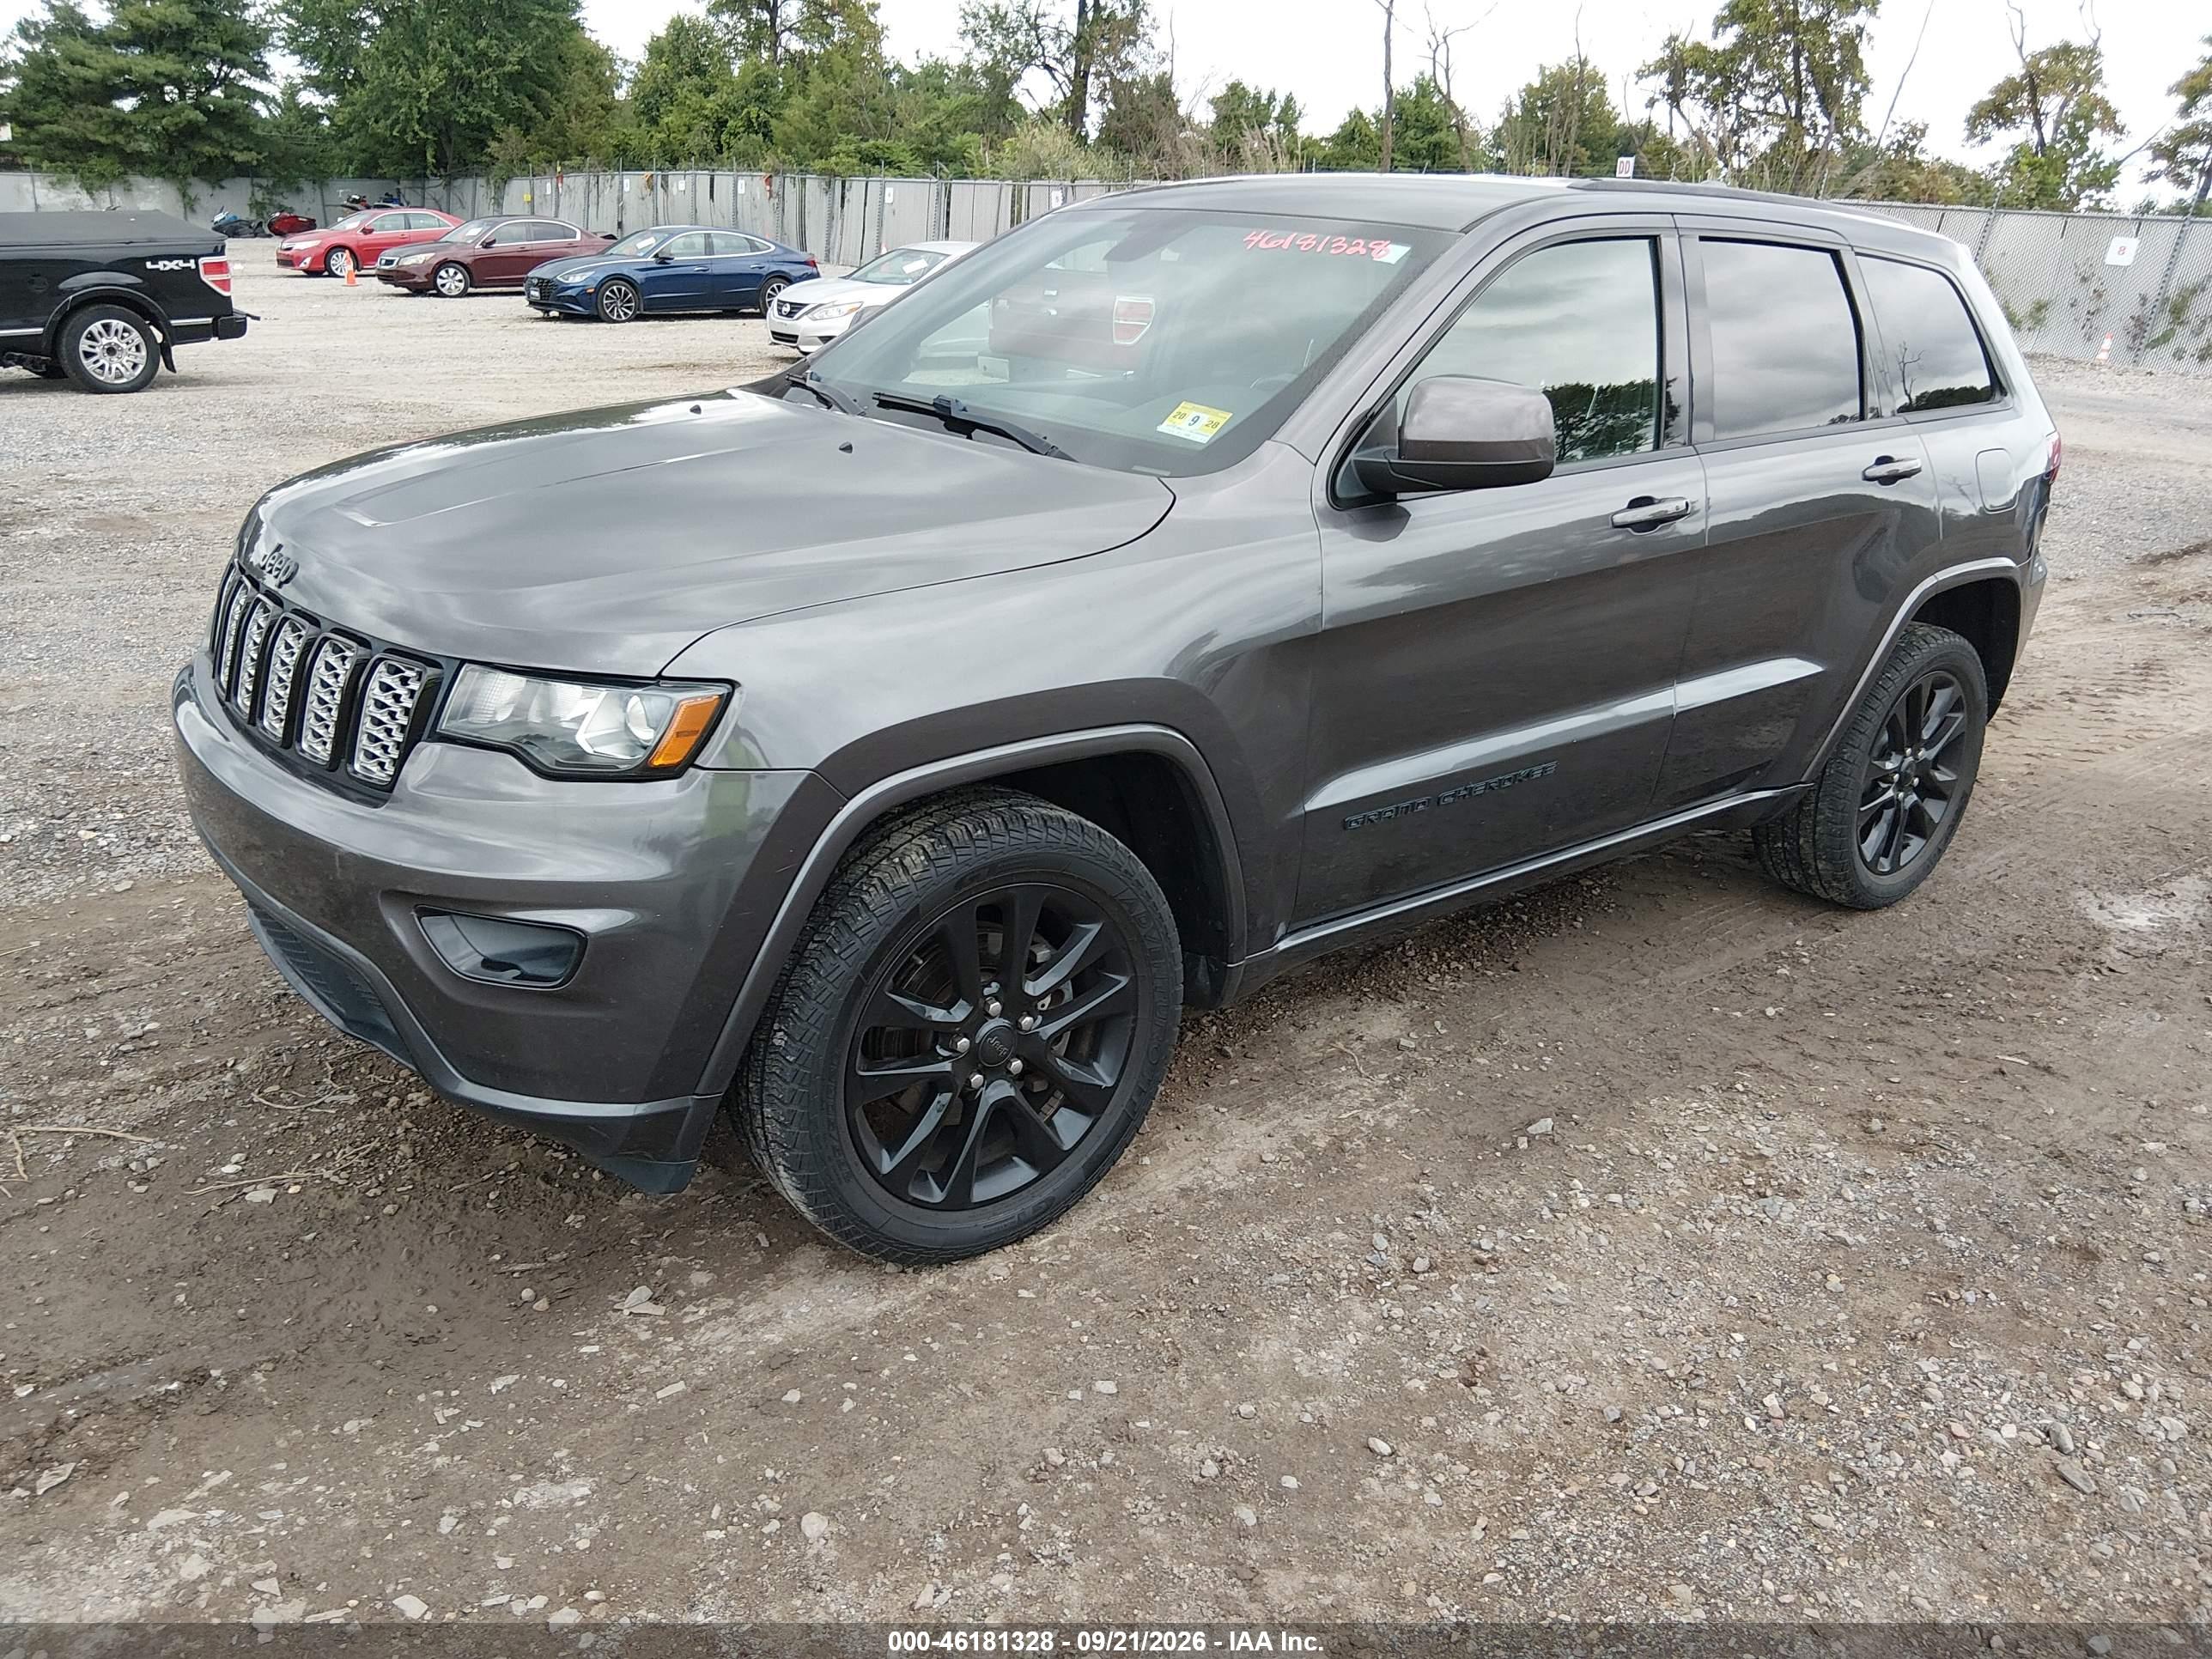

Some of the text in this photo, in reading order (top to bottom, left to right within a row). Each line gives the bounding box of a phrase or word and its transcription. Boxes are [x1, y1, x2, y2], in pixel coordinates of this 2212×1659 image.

[1243, 229, 1392, 261] 46181328
[1172, 411, 1187, 420] 20
[1188, 415, 1200, 427] 9
[259, 543, 300, 589] Jeep
[1343, 761, 1559, 830] GRAND CHEROKEE
[987, 1036, 1009, 1057] Jeep
